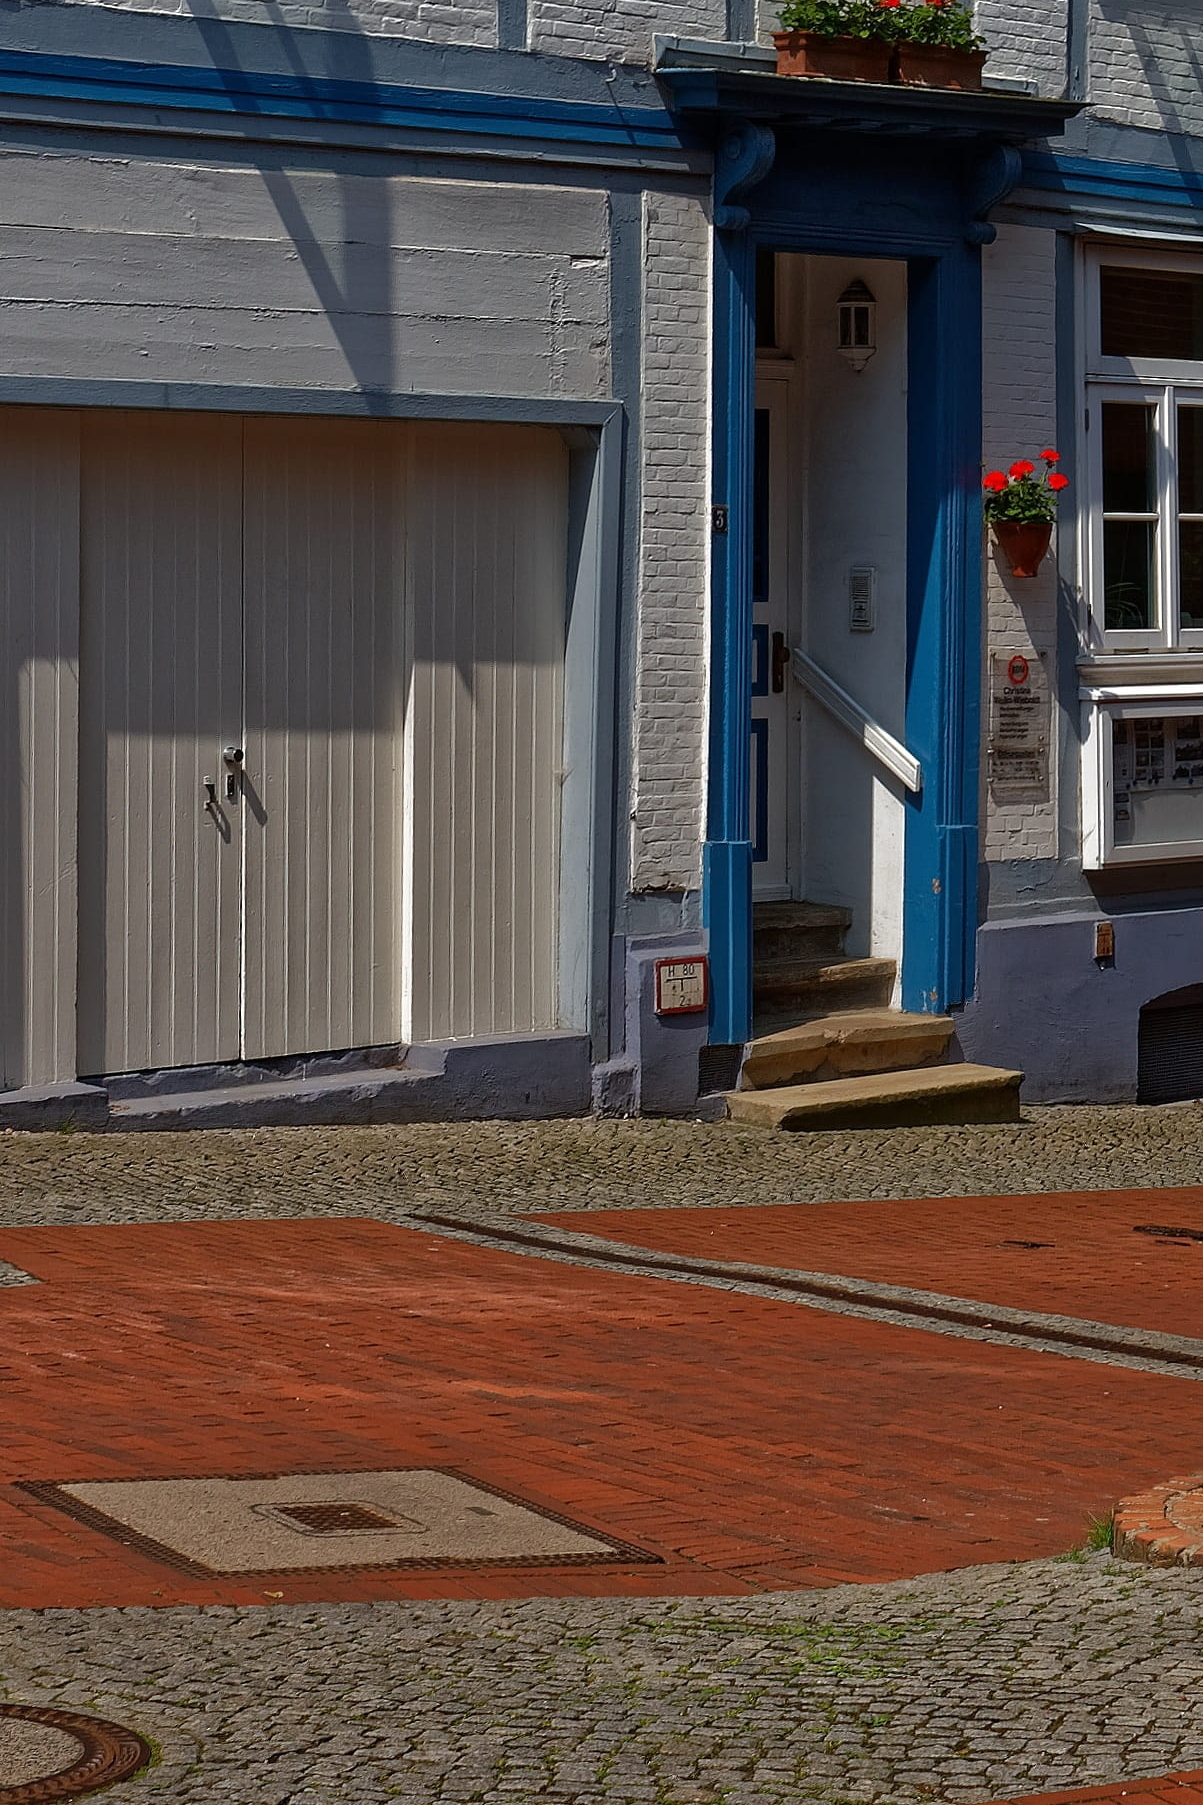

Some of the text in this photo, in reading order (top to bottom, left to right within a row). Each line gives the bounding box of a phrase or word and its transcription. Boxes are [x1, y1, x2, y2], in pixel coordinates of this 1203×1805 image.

[716, 509, 724, 528] 3
[668, 963, 695, 977] H 80
